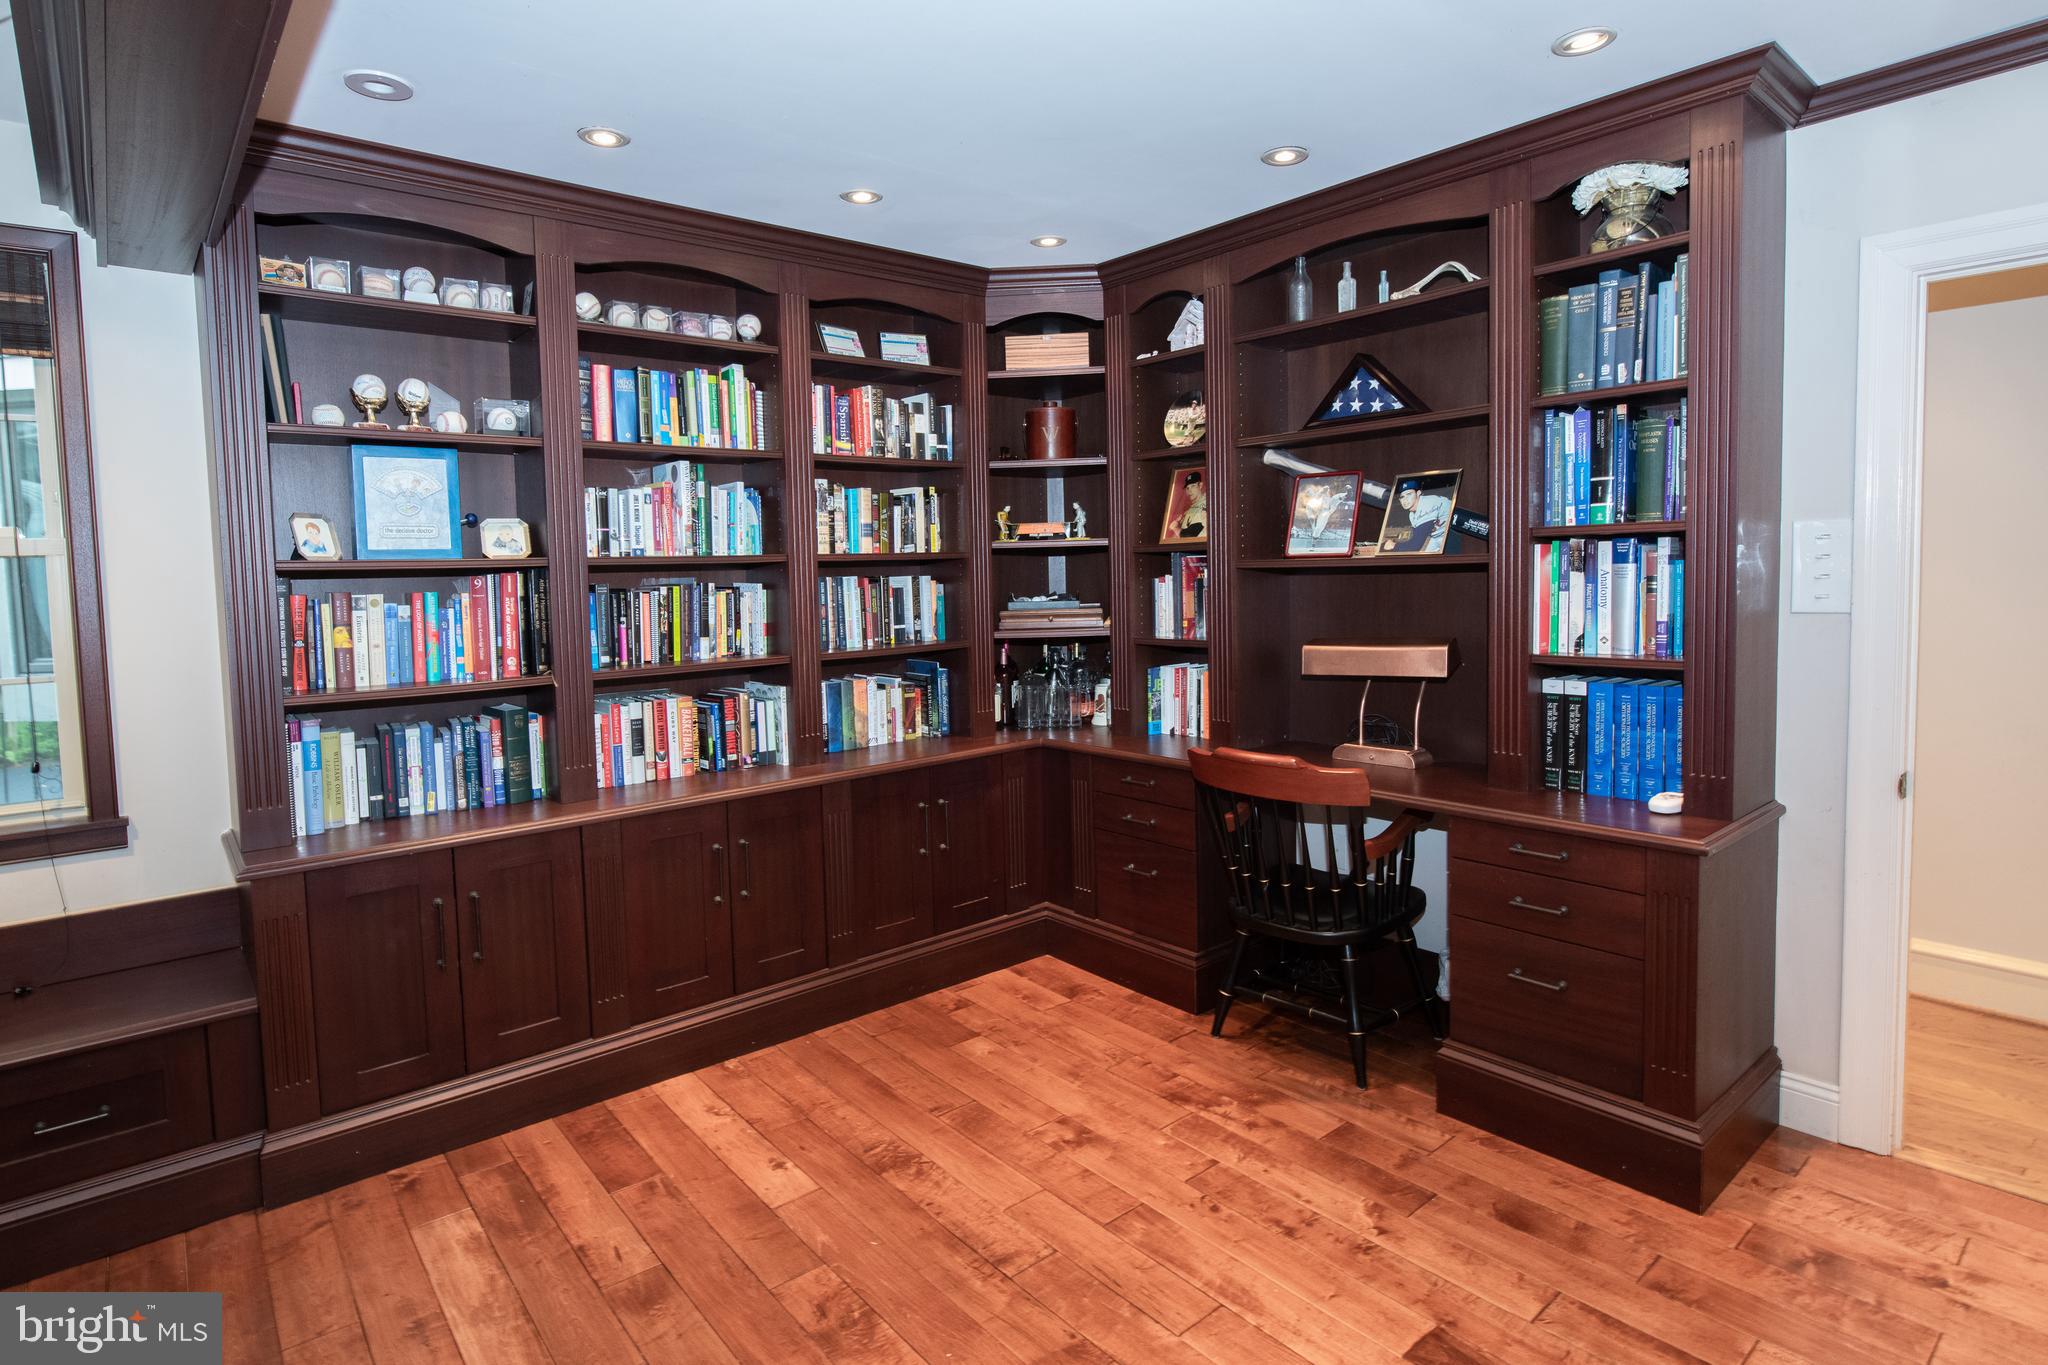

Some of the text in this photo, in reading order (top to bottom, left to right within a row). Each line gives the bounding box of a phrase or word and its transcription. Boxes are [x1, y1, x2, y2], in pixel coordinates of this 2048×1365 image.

[838, 407, 849, 442] Spanish
[1598, 569, 1609, 608] Anatomy
[295, 608, 303, 618] LEE
[491, 734, 501, 745] Stem
[656, 702, 665, 750] MEDICAL APARTHEID
[682, 710, 693, 755] BASKETBALL
[724, 699, 737, 754] IRON MIKE
[312, 786, 320, 809] Pathology
